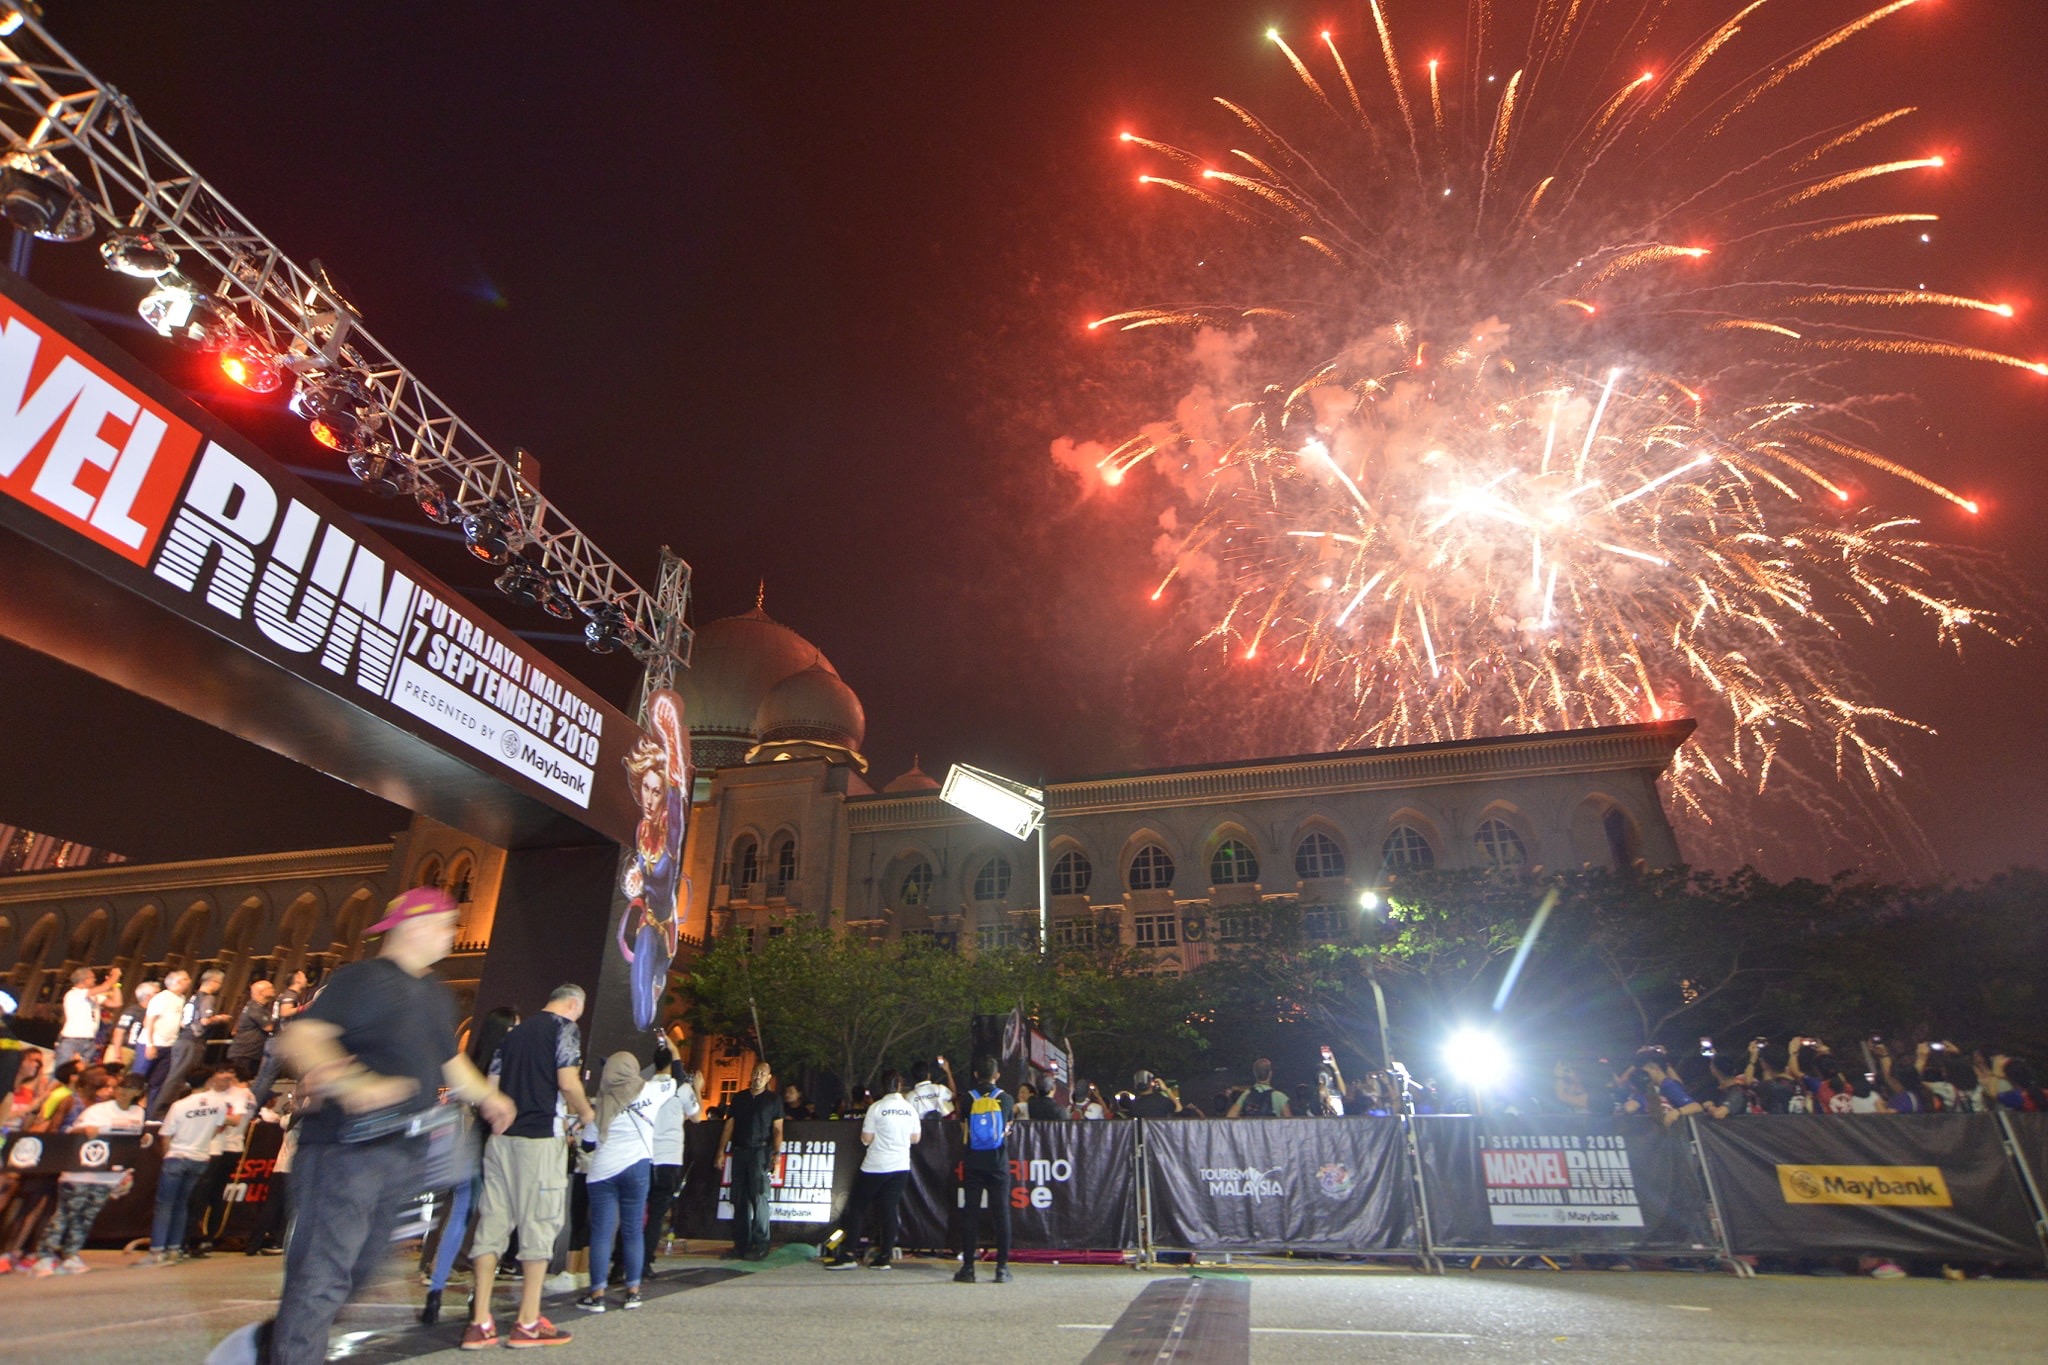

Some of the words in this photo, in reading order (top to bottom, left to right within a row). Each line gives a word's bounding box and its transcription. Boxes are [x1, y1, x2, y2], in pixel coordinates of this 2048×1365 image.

[0, 315, 168, 550] VEL
[153, 440, 415, 697] RUN
[416, 588, 524, 685] PUTRAJAYA
[529, 667, 603, 737] MALAYSIA
[407, 619, 428, 656] 7
[427, 633, 554, 739] SEPTEMBER
[553, 716, 600, 767] 2019
[404, 680, 477, 730] PRESENTED
[480, 724, 496, 740] BY
[520, 743, 585, 795] Maybank
[185, 1107, 219, 1119] CREW
[881, 1108, 912, 1117] OFFICIAL
[805, 1141, 836, 1153] 2019
[1477, 1135, 1486, 1149] 7
[1492, 1135, 1582, 1149] SEPTEMBER
[1587, 1135, 1626, 1149] 2019
[784, 1153, 835, 1188] RUN
[1200, 1168, 1249, 1181] TOURISM
[1482, 1151, 1568, 1185] MARVEL
[1564, 1150, 1635, 1188] RUN
[1209, 1179, 1284, 1202] MALAYSIA
[1486, 1188, 1563, 1204] PUTRAJAYA
[1568, 1189, 1639, 1205] MALAYSIA
[1822, 1175, 1937, 1199] Maybank
[773, 1207, 812, 1219] Maybank
[1567, 1211, 1620, 1224] Maybank
